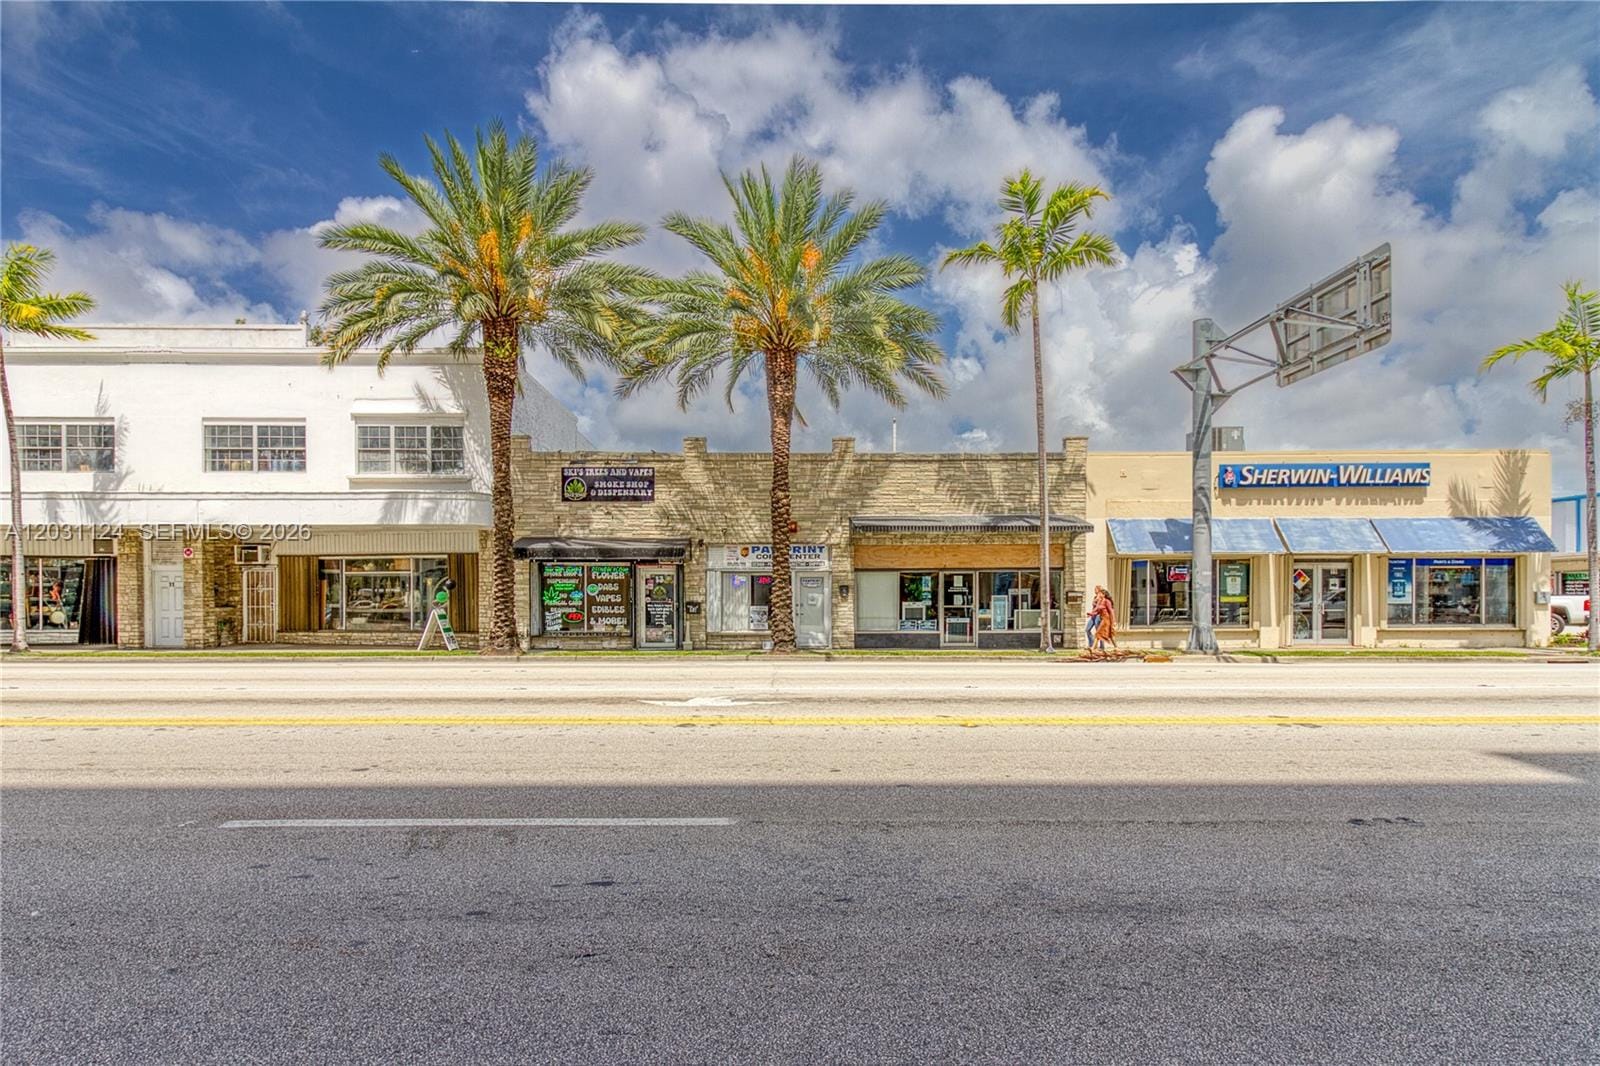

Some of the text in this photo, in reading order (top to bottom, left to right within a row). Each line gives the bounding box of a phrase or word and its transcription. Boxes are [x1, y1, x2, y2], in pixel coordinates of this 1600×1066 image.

[563, 468, 653, 476] SKI'S TREES AND VAPES
[1239, 464, 1431, 486] SHERWIN-WILLIAMS
[598, 489, 653, 497] DISPENSARY
[595, 594, 622, 602] VAPES
[591, 605, 625, 614] EDIBLES
